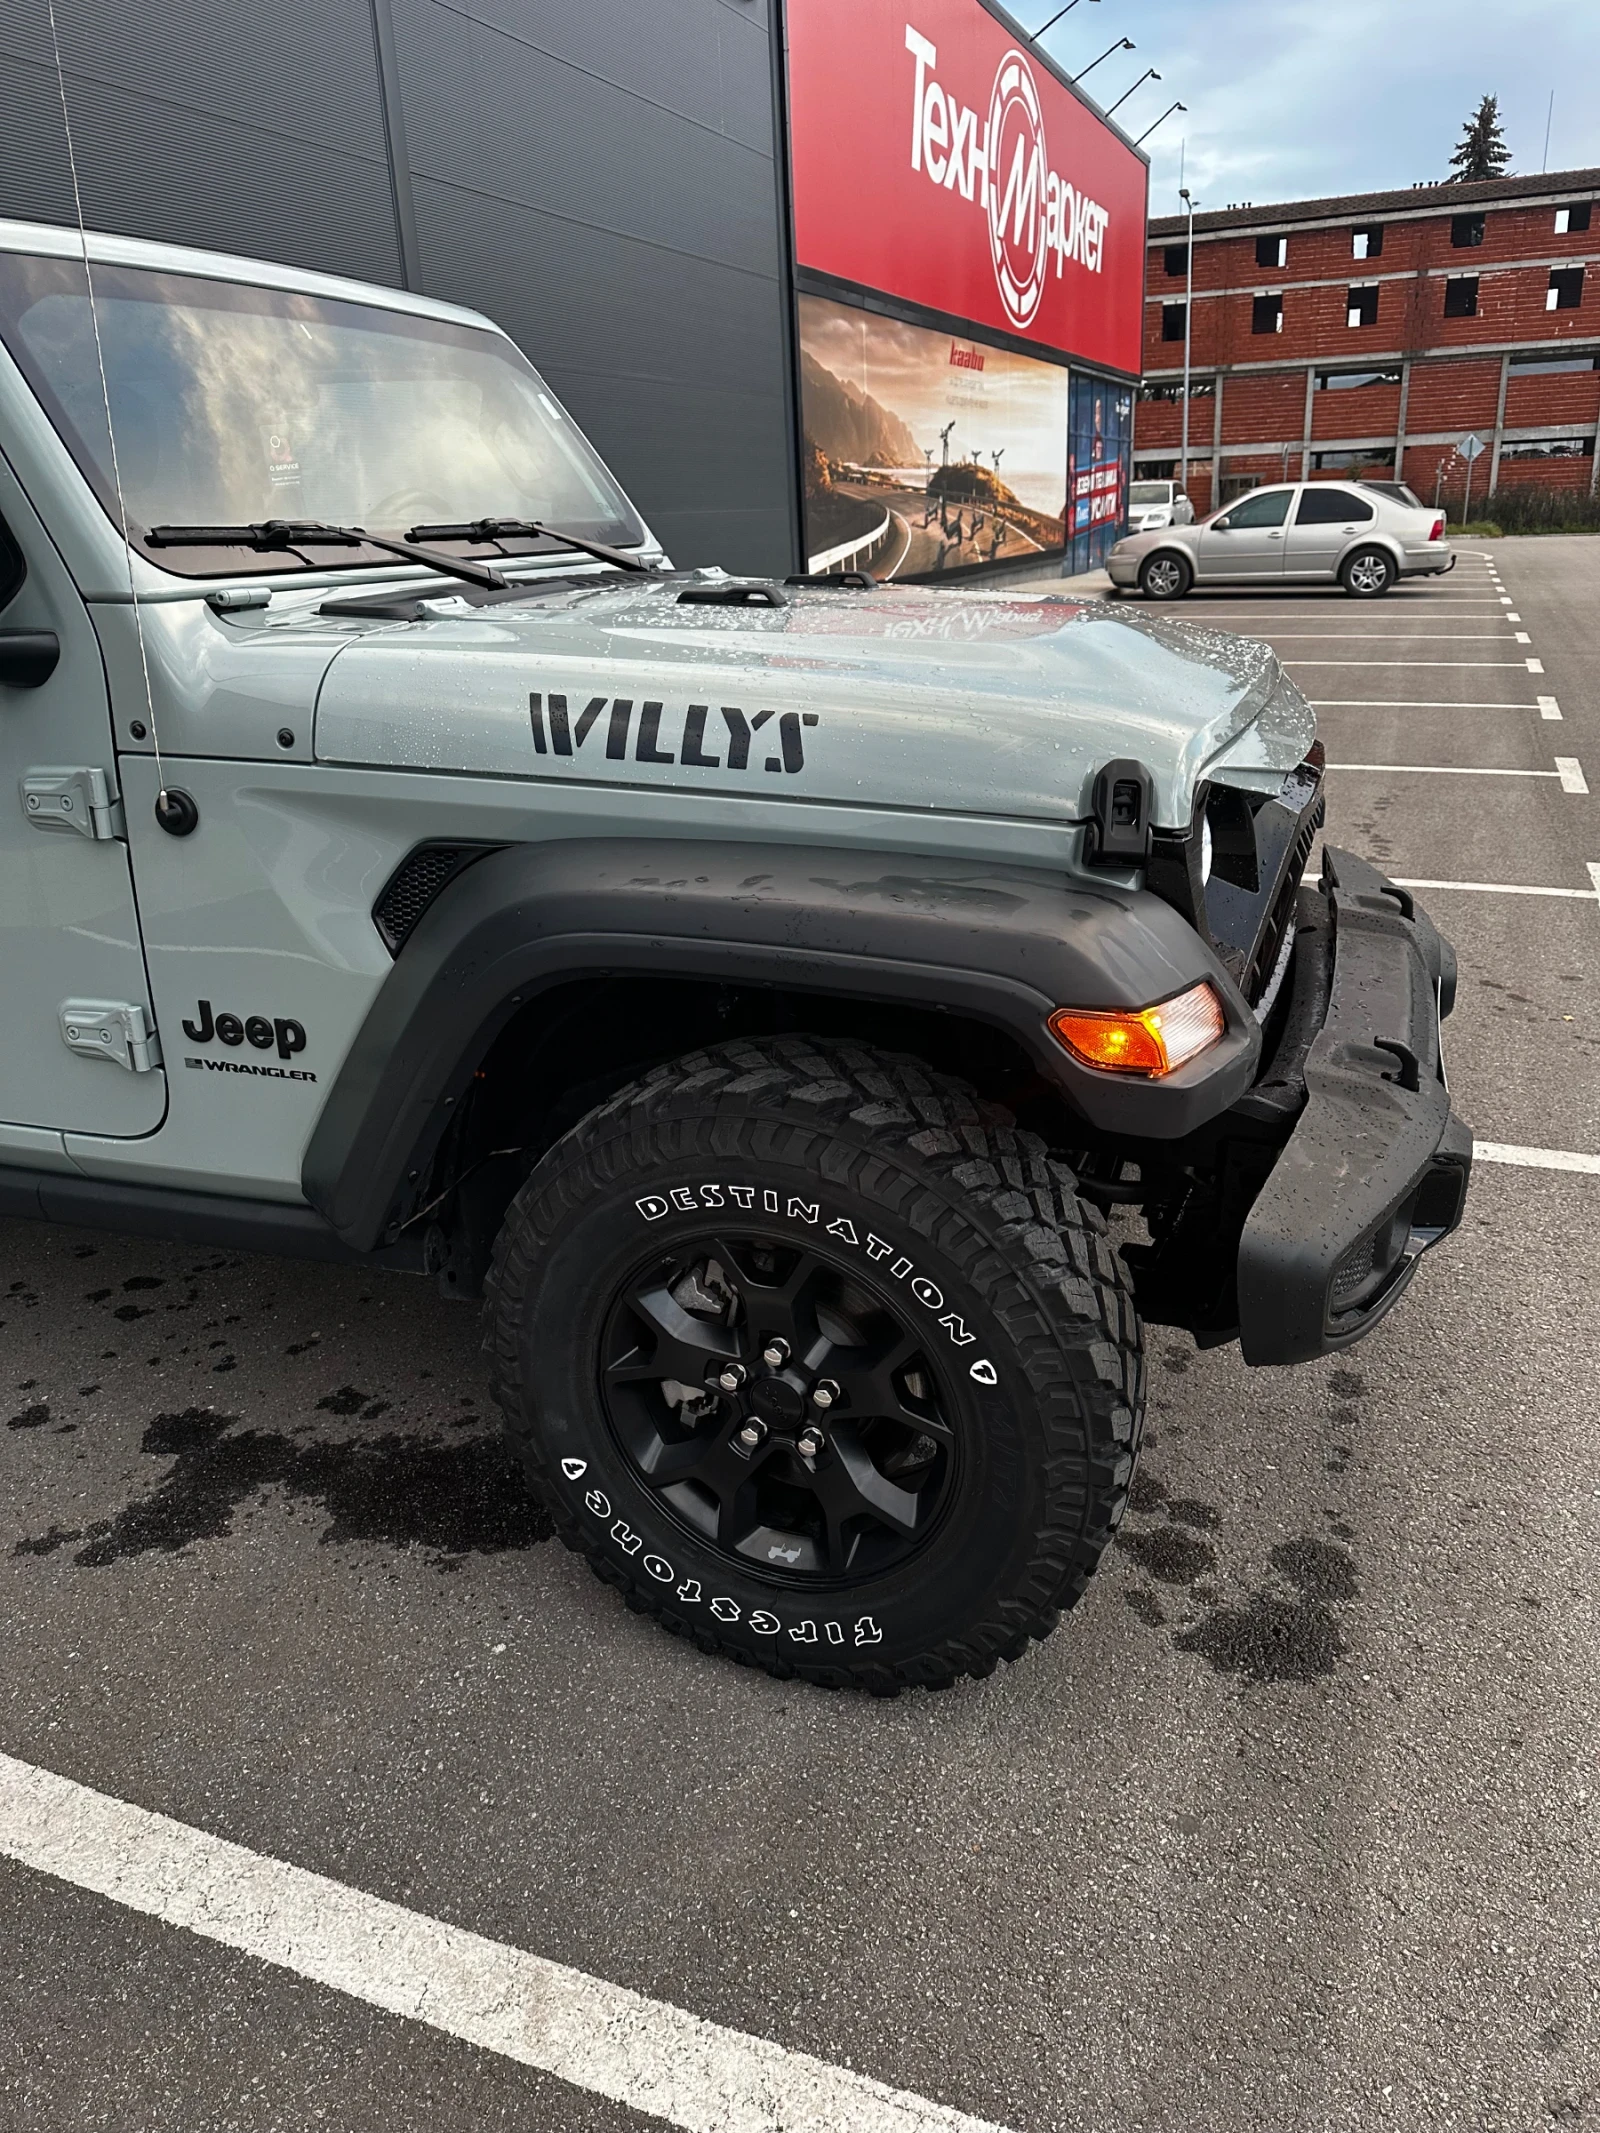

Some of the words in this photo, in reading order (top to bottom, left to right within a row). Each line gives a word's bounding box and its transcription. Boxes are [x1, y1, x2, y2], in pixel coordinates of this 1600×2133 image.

[949, 339, 985, 371] kaabo
[529, 692, 820, 774] WILLYS
[181, 1000, 307, 1060] Jeep
[203, 1059, 318, 1083] WRANGLER
[635, 1183, 976, 1347] DESTINATION
[584, 1490, 884, 1647] Firestone
